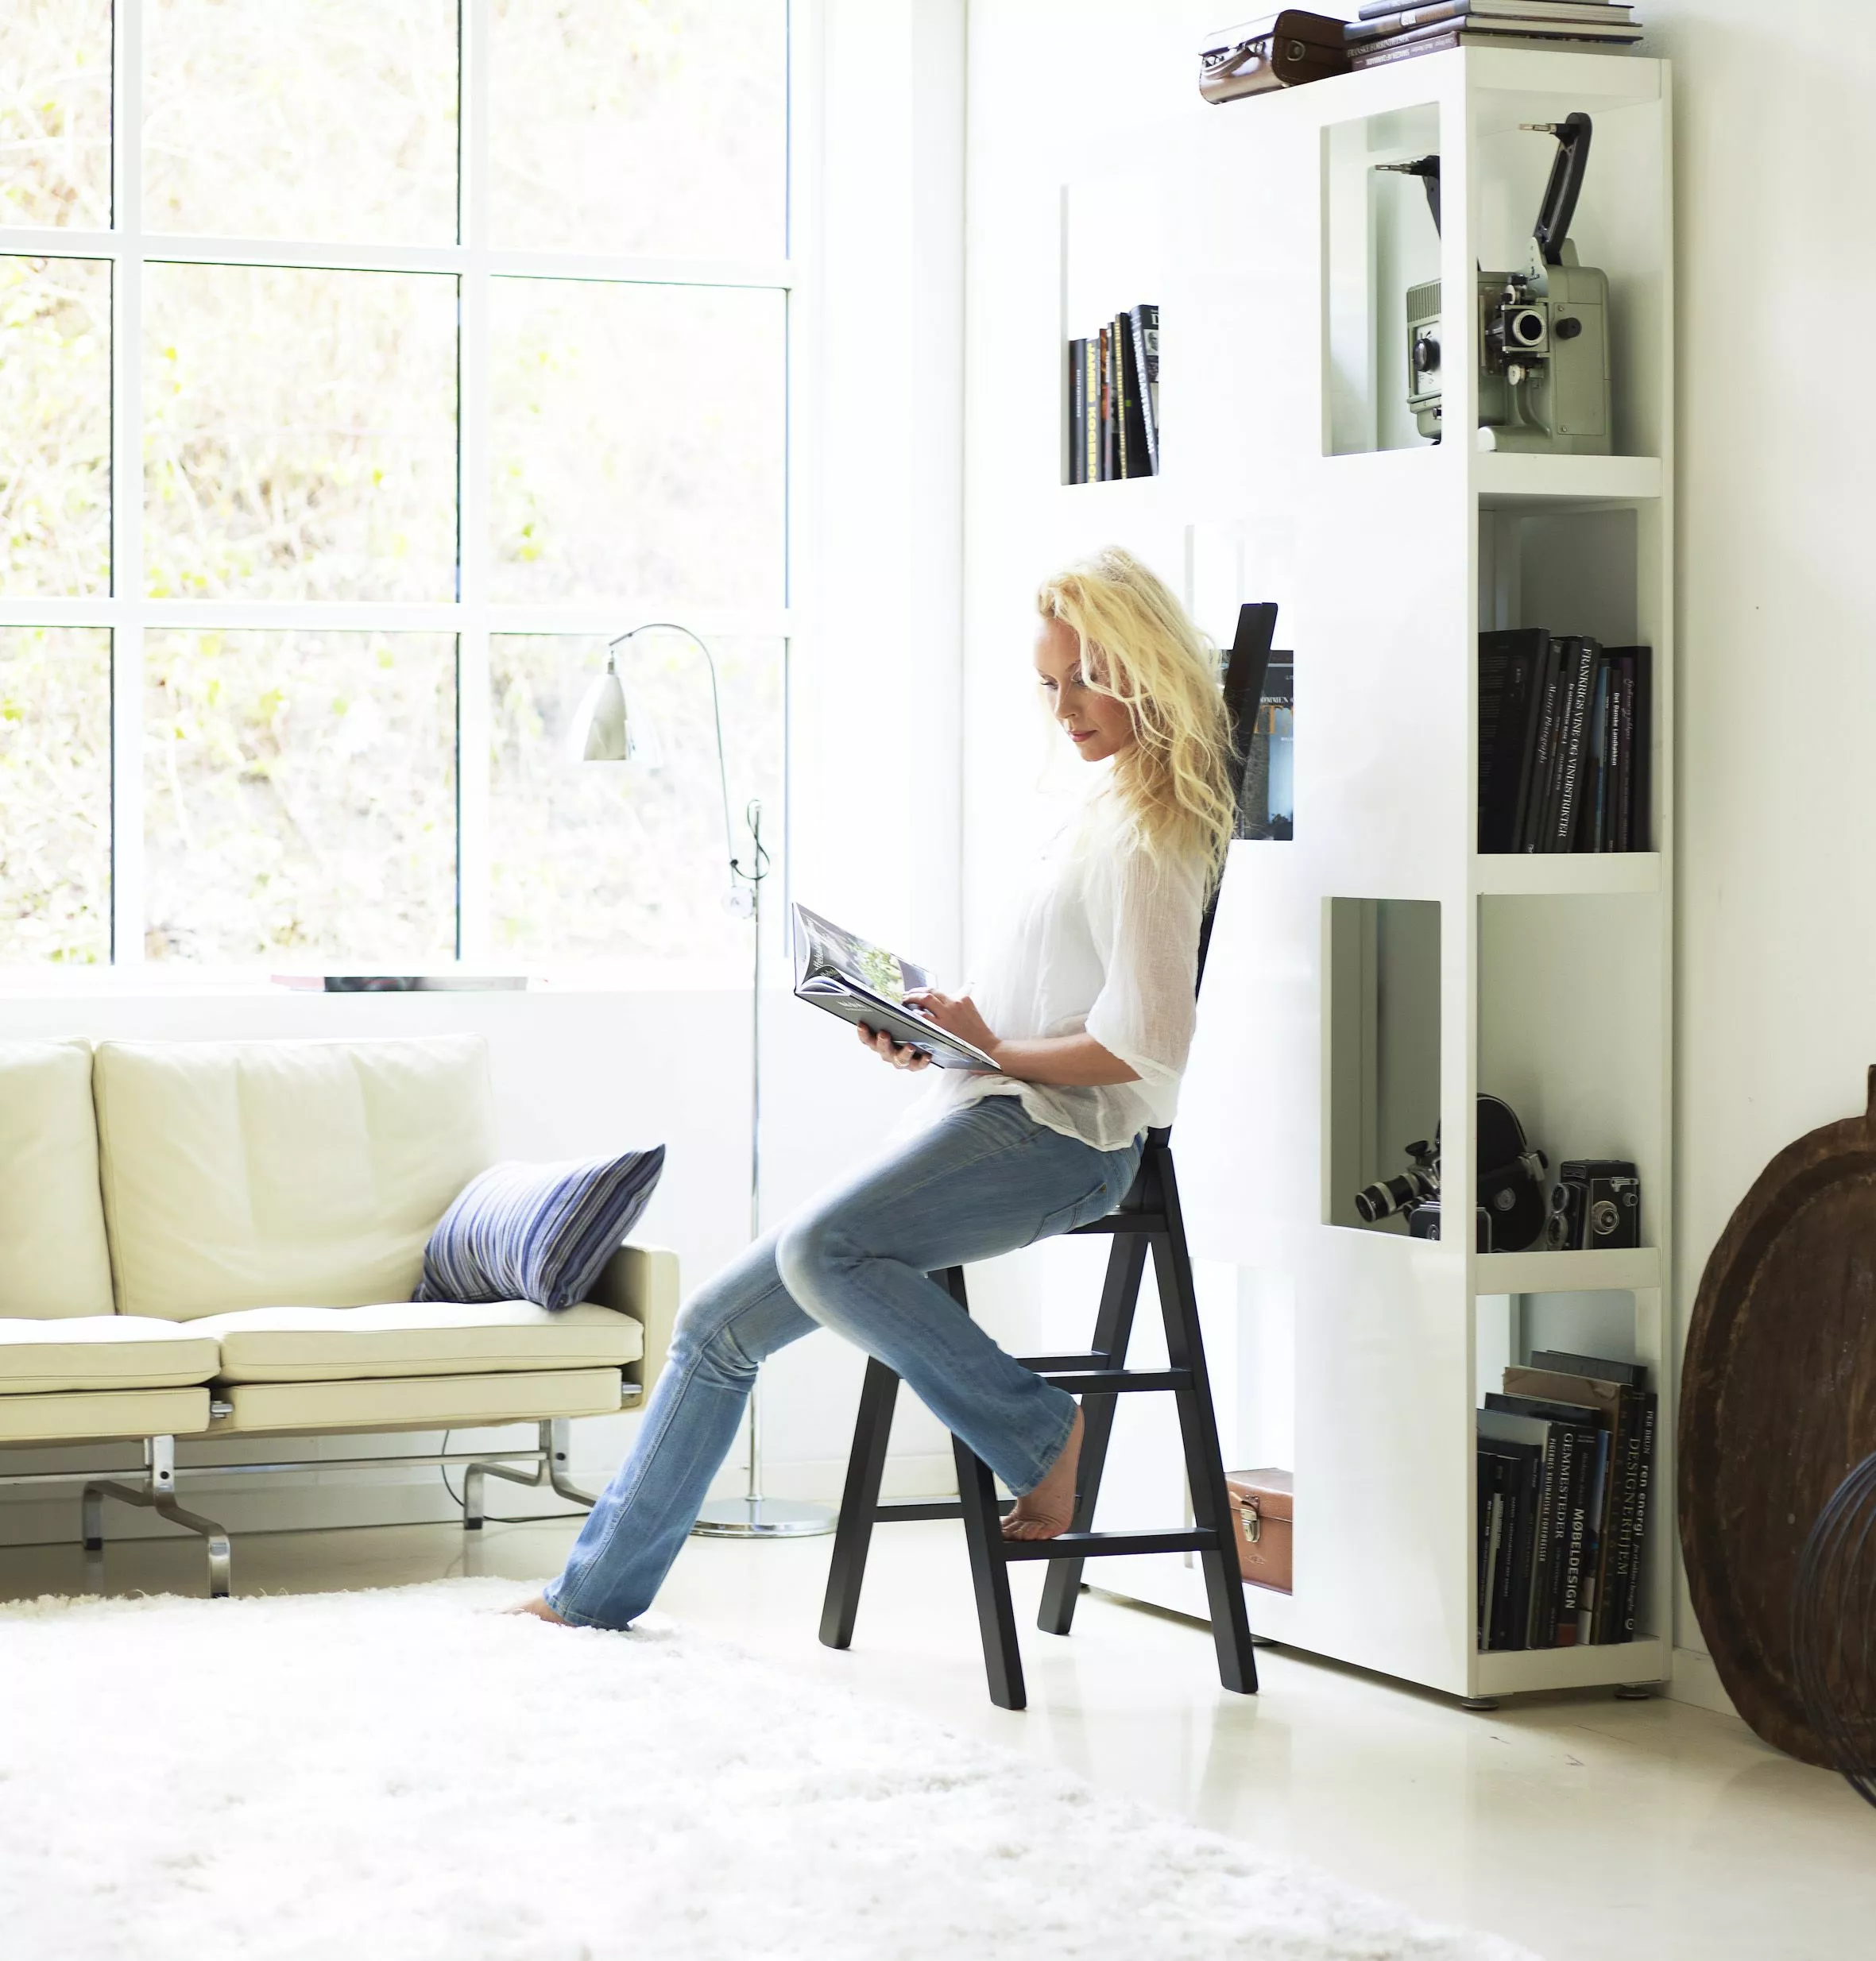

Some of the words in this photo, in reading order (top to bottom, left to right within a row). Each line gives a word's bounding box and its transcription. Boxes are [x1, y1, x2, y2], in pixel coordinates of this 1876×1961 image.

[1087, 343, 1097, 402] JAMIES
[1546, 683, 1557, 714] Master
[1575, 648, 1592, 709] FRANKRIGS
[1537, 715, 1553, 764] Photographs
[1568, 737, 1580, 755] OG
[1570, 711, 1583, 736] VINE
[1557, 757, 1576, 837] VINDISTRIKTER
[1546, 1437, 1557, 1469] PIGERNES
[1642, 1429, 1652, 1454] BRUN
[1542, 1472, 1553, 1514] KULINARISKE
[1555, 1432, 1573, 1539] GEMMESTEDER
[1638, 1464, 1650, 1487] ren
[1617, 1437, 1641, 1576] DESIGNERHJEM
[1632, 1491, 1647, 1537] energi
[1565, 1507, 1584, 1609] MØBELDESIGN
